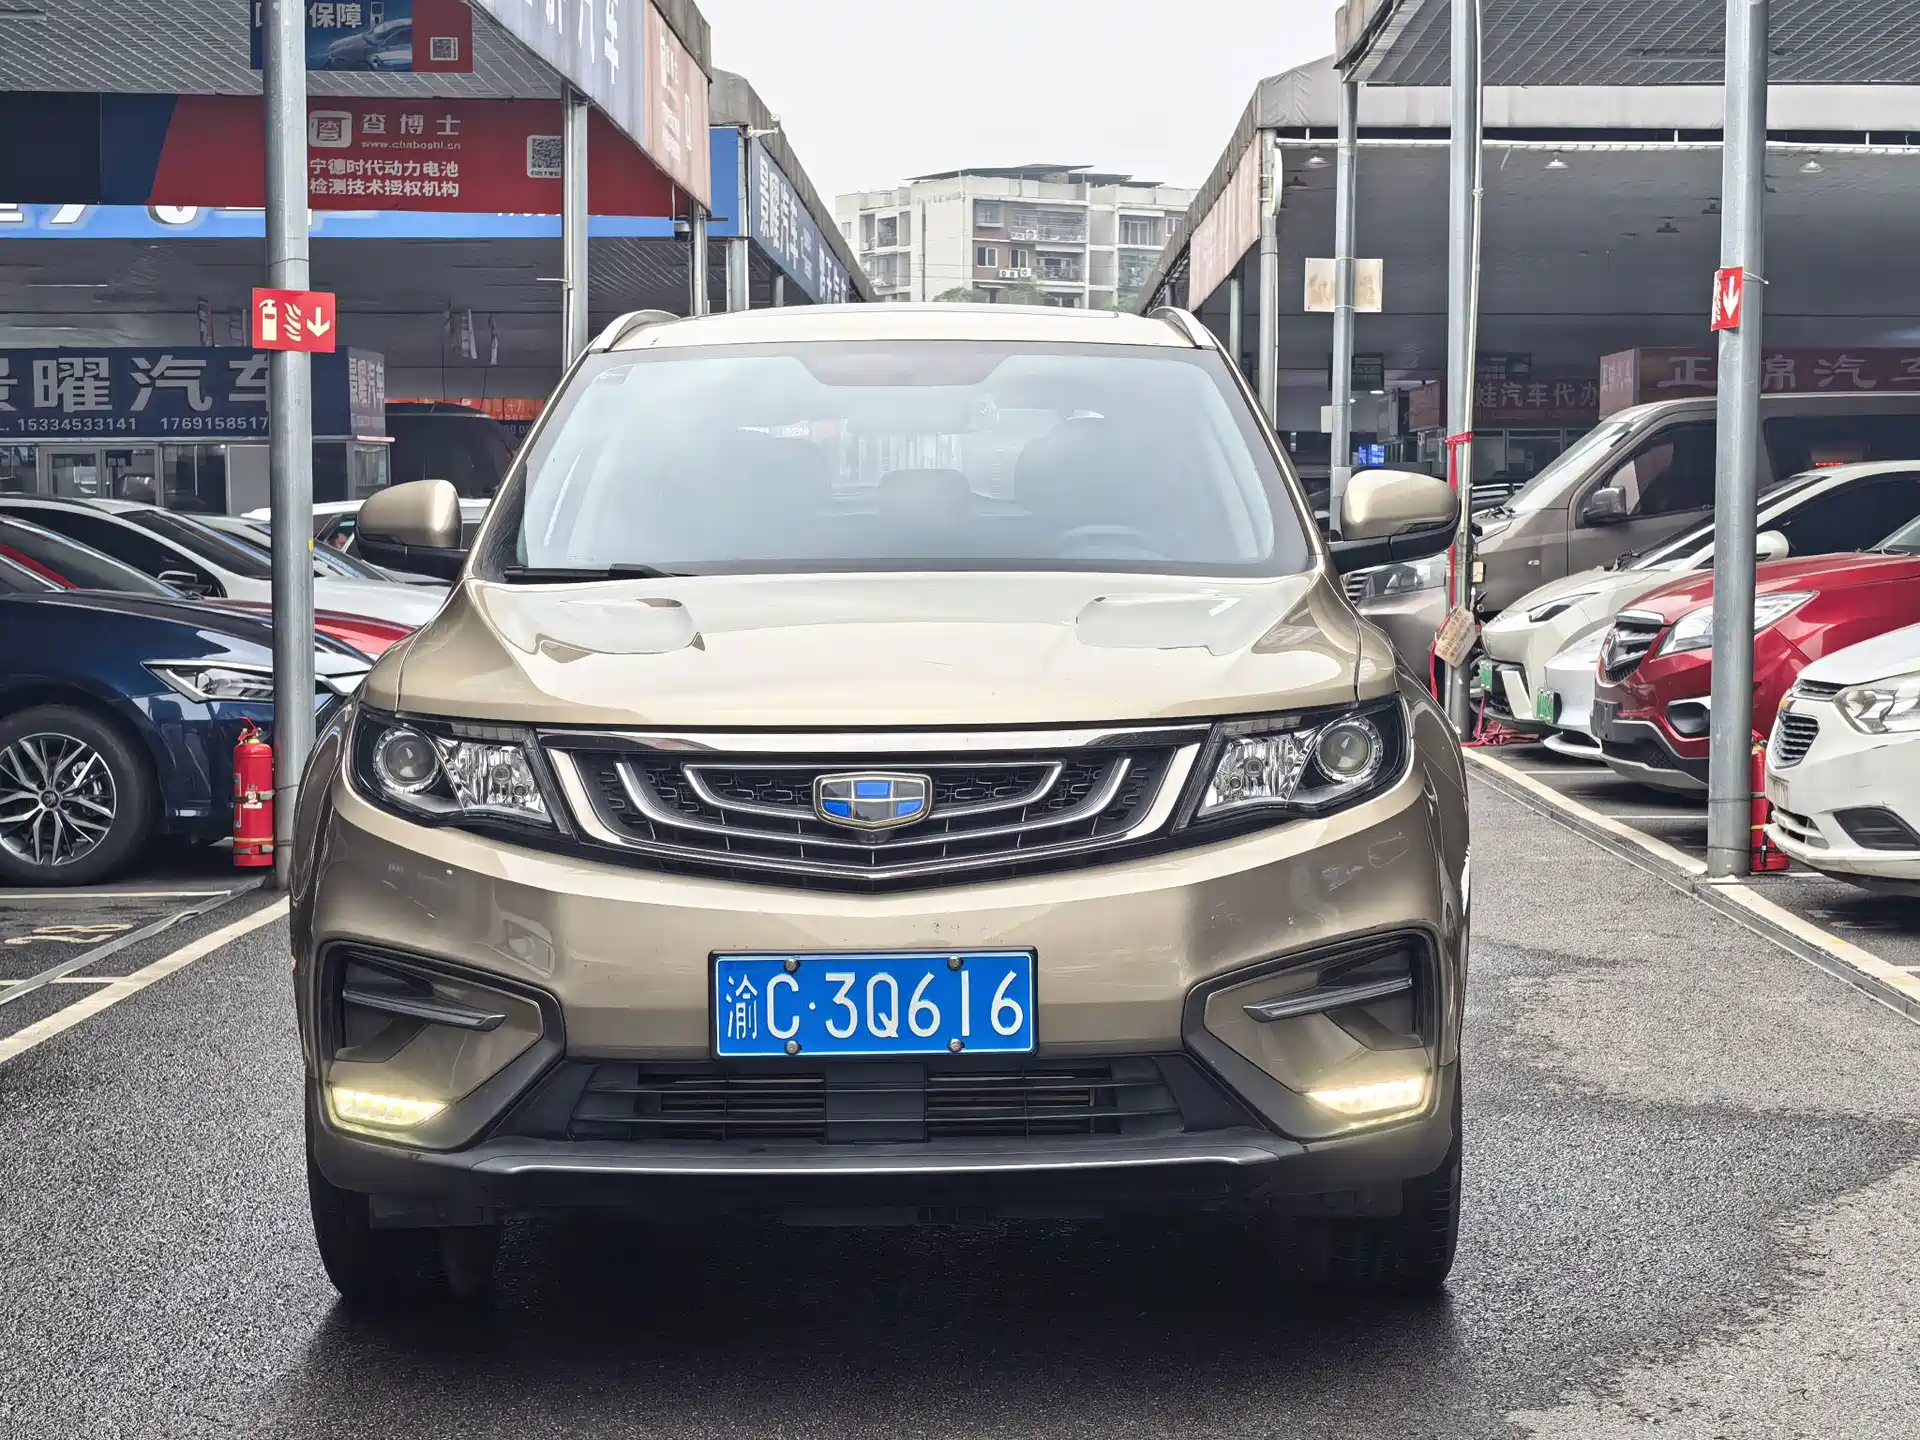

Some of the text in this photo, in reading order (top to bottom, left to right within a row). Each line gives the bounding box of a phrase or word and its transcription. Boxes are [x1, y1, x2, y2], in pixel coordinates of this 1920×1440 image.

[361, 113, 461, 135] 查博士
[309, 158, 460, 177] 宁德时代动力电池
[309, 178, 460, 197] 检测技术授权机构
[17, 417, 137, 432] 15334533141
[160, 416, 268, 431] 1769158517
